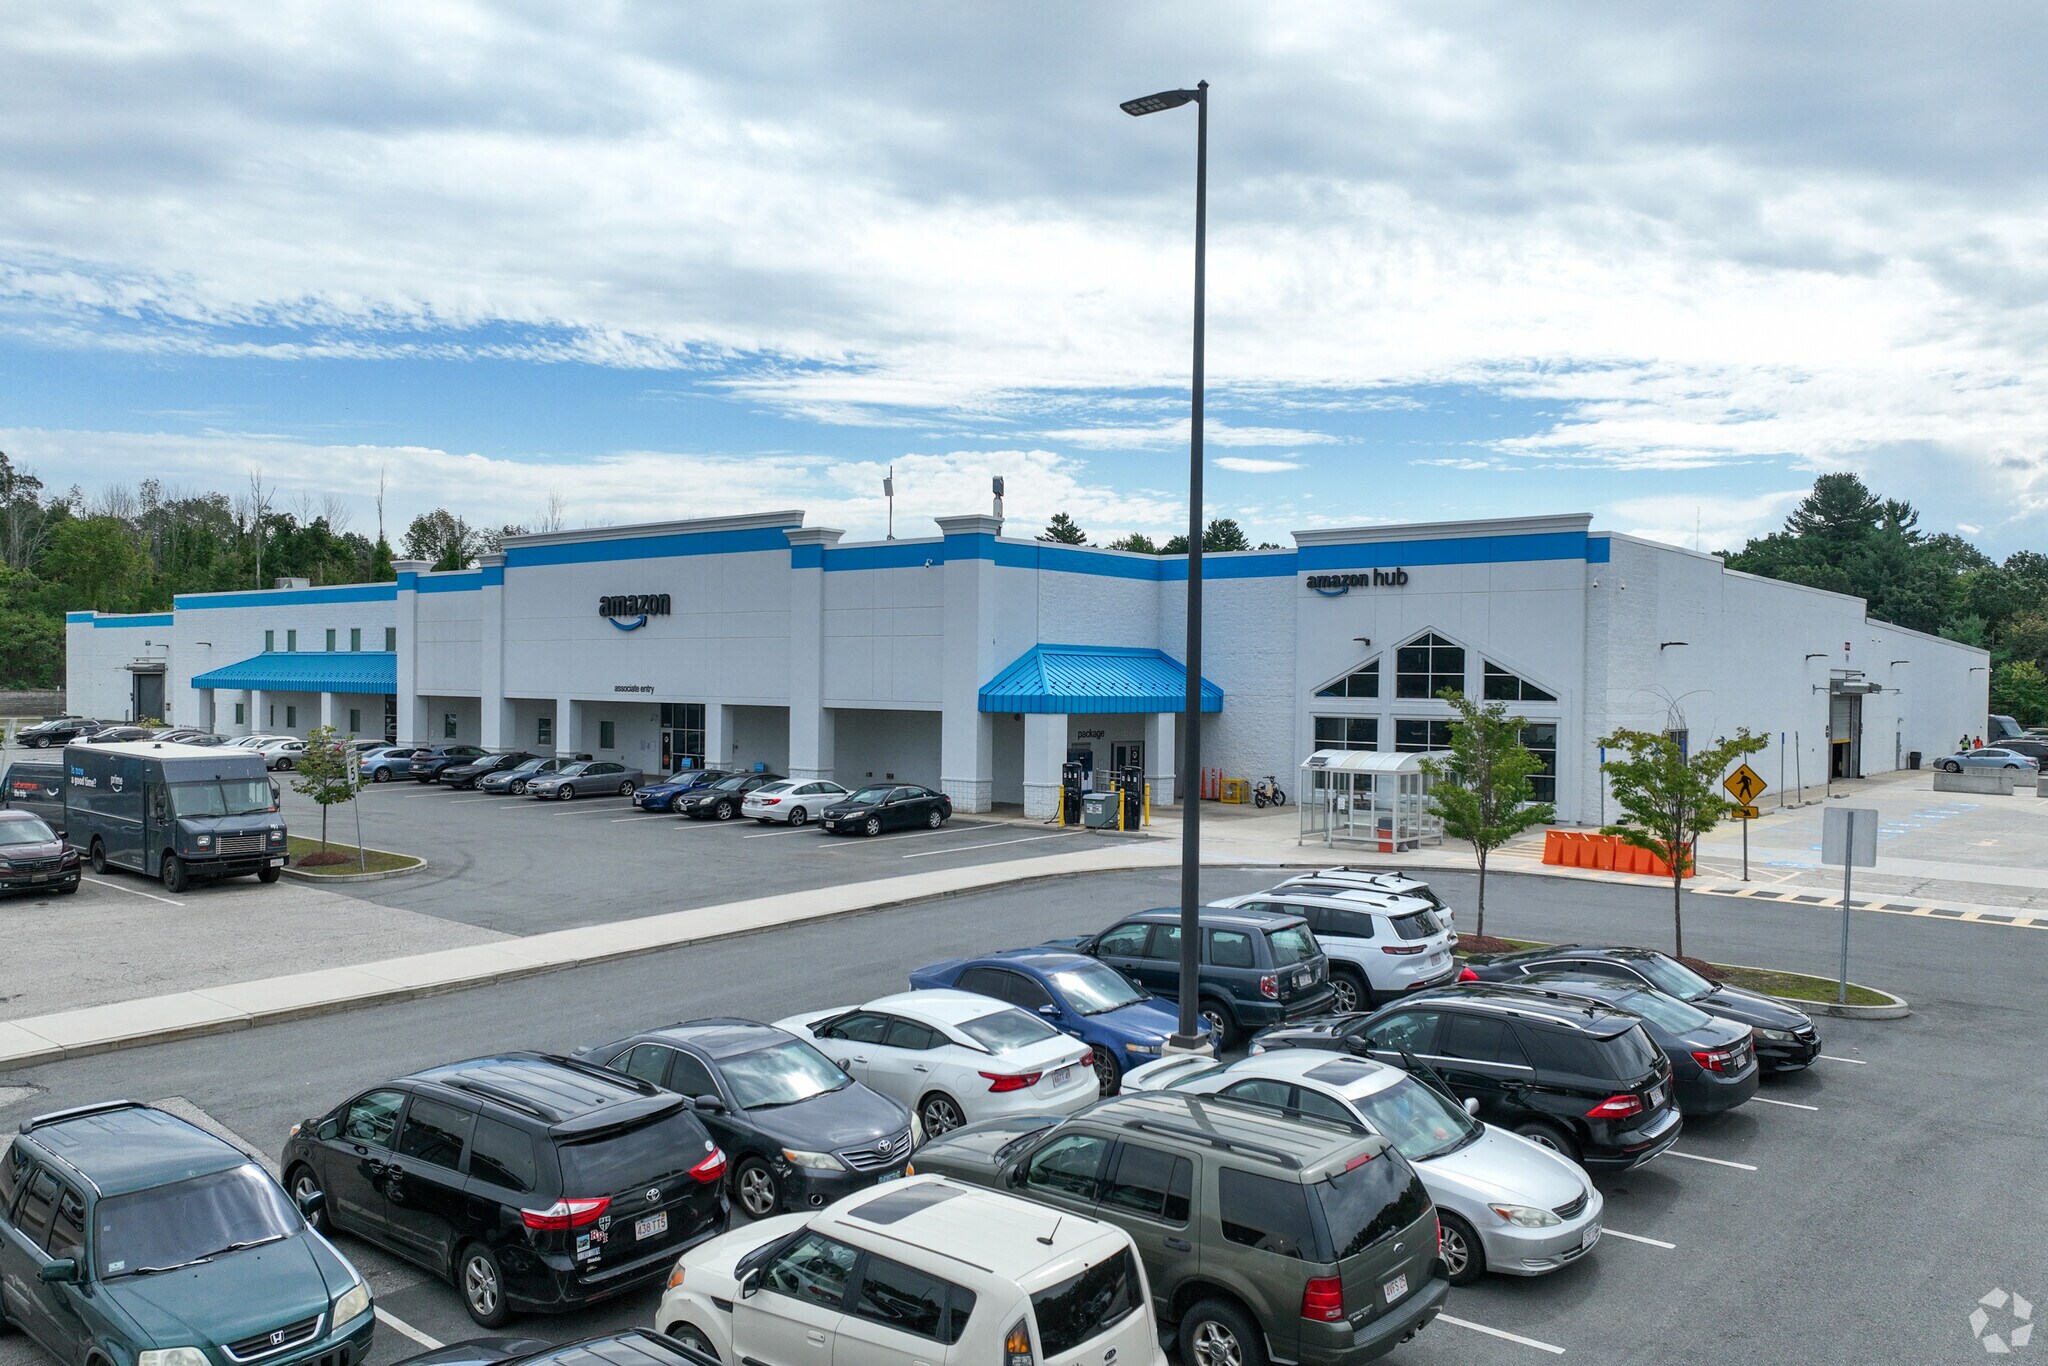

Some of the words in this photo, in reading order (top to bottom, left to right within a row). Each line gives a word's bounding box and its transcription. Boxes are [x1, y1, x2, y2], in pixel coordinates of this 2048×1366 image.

[1306, 573, 1368, 588] amazon
[1373, 567, 1409, 586] hub
[598, 593, 671, 617] amazon
[614, 684, 640, 693] associate
[640, 685, 655, 695] entry
[1077, 728, 1105, 740] package
[110, 774, 123, 786] prime
[350, 766, 356, 781] 5
[74, 776, 85, 787] good
[84, 776, 97, 788] time?
[637, 1222, 651, 1236] 438
[653, 1218, 666, 1230] TT5
